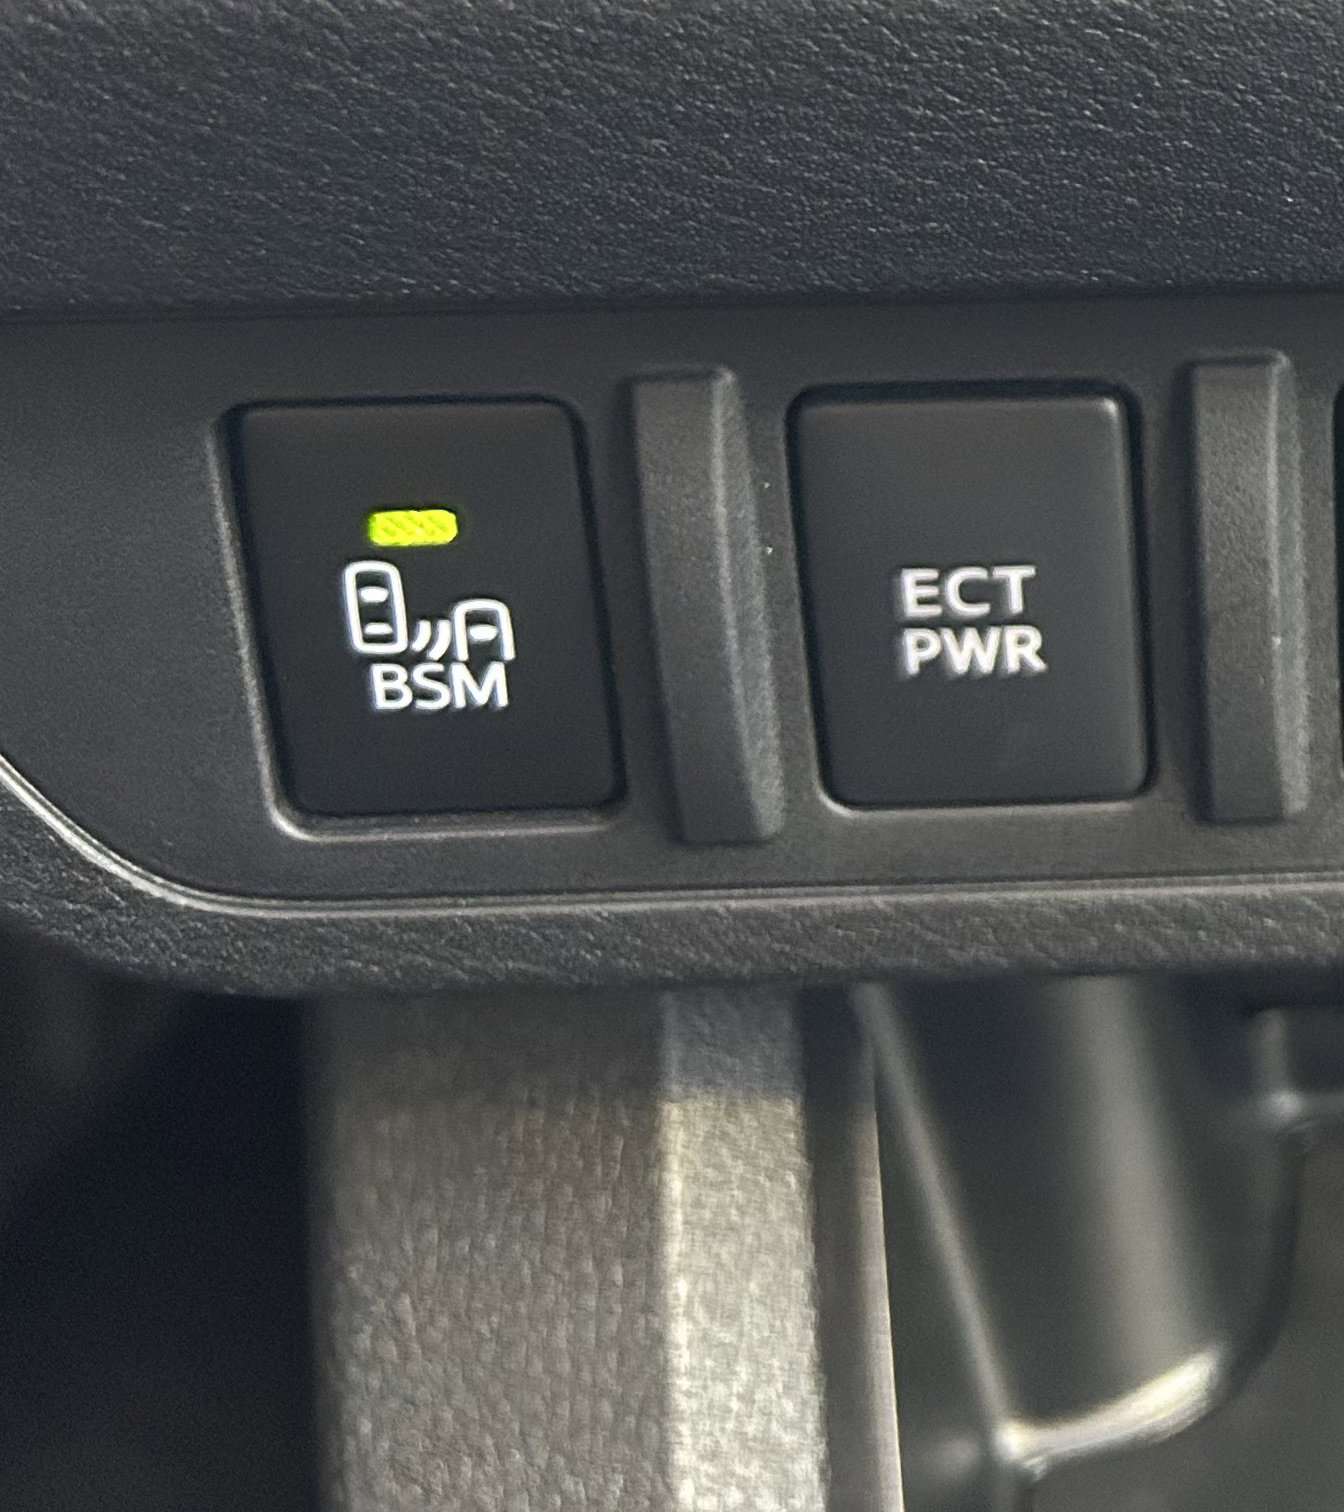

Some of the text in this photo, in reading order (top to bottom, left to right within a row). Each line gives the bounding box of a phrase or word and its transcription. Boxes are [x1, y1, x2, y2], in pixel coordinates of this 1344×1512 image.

[900, 564, 1038, 619] ECT
[902, 624, 1048, 676] PWR
[370, 660, 510, 711] BSM
